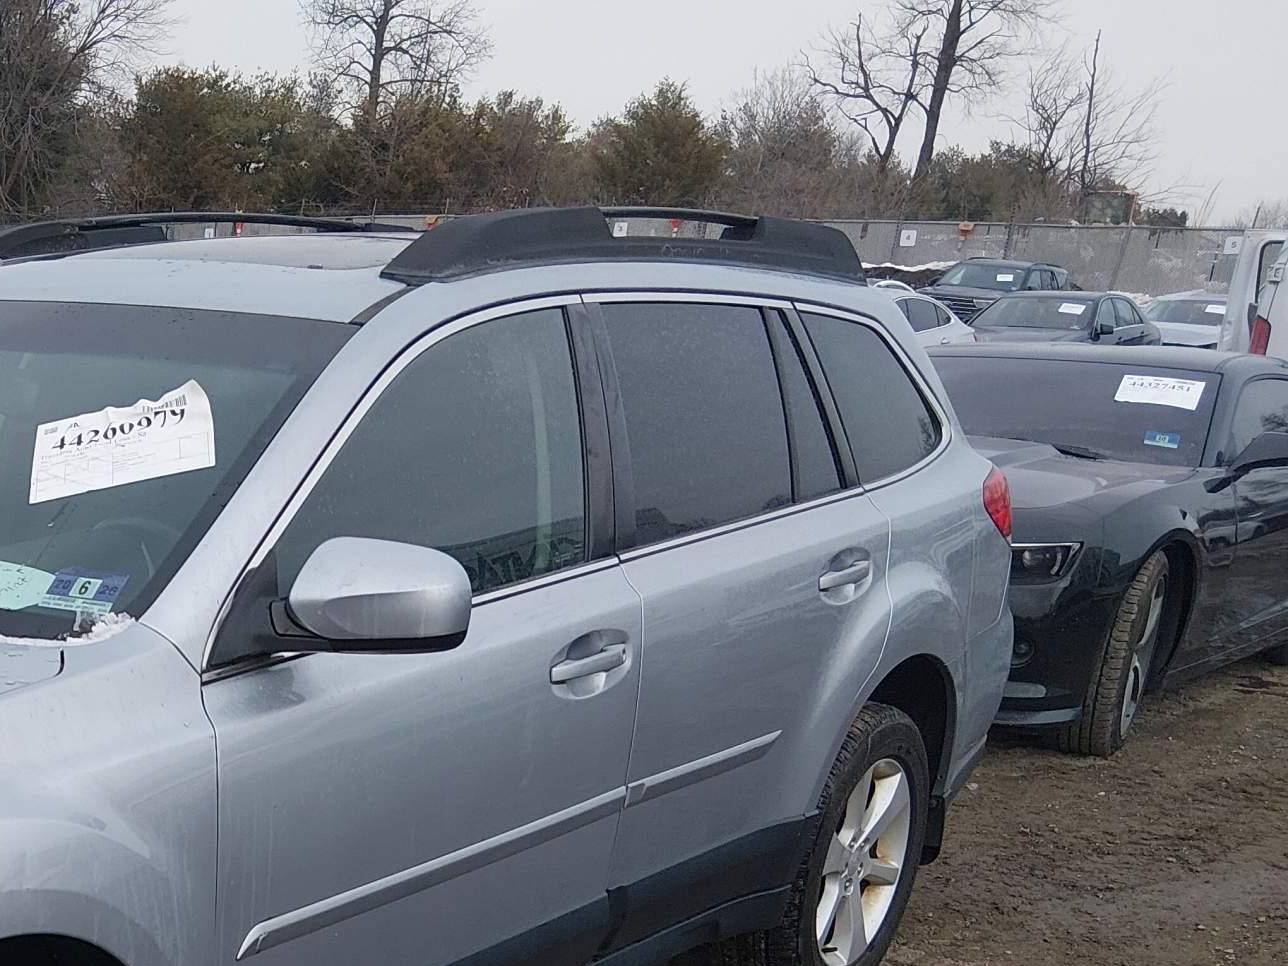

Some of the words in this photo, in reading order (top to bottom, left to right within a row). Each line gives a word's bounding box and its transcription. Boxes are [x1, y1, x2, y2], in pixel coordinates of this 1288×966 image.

[51, 408, 185, 450] 44260979
[54, 579, 72, 590] 20
[78, 580, 92, 595] 6
[98, 585, 118, 596] 26
